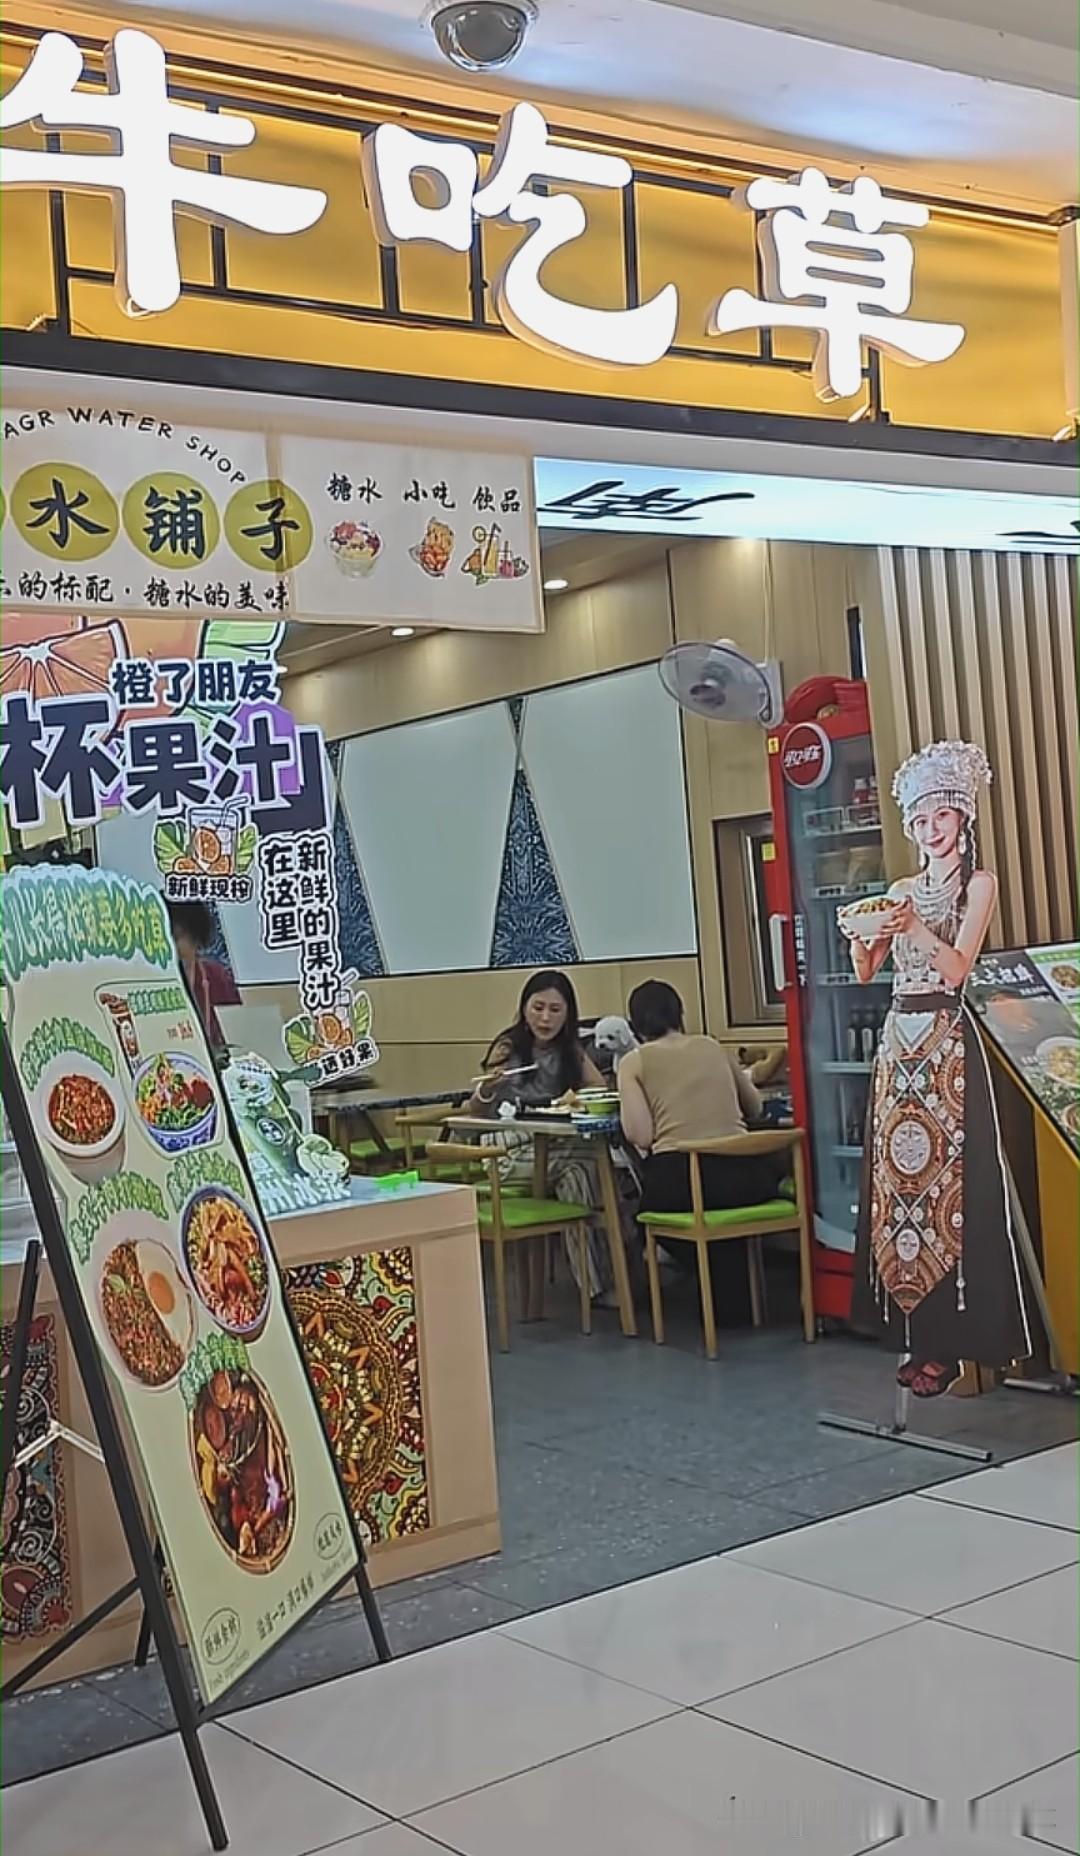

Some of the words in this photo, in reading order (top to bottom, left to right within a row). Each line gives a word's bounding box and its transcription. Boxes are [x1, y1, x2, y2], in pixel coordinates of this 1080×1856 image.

[0, 30, 964, 396] 牛吃草
[67, 406, 173, 440] WATER
[186, 435, 246, 485] SHOP
[26, 477, 301, 561] 水铺子
[327, 472, 384, 502] 糖水
[403, 479, 456, 510] 小吃
[472, 486, 522, 513] 饮品
[112, 660, 278, 703] 橙了朋友
[263, 842, 299, 947] 在这里
[298, 840, 339, 1007] 新鲜的果汁
